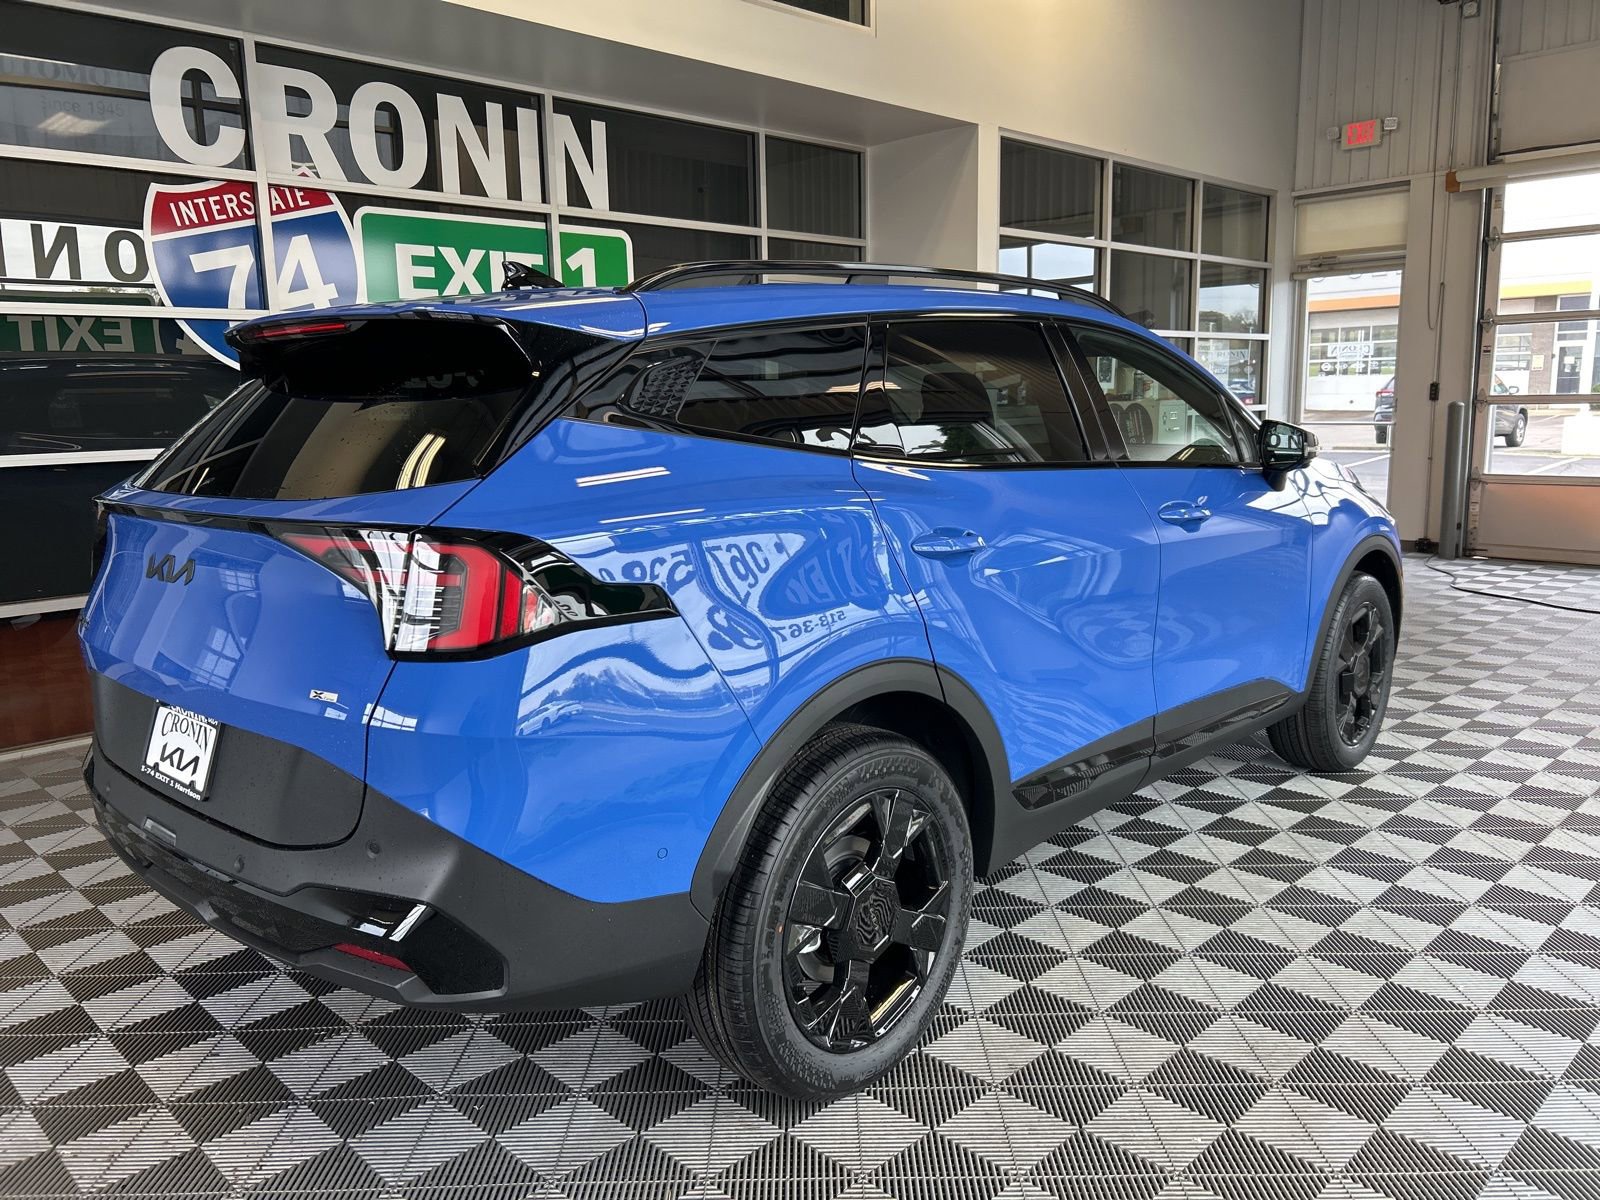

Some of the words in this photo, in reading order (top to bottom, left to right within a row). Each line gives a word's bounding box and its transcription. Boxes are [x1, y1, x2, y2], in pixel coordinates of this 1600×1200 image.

[150, 46, 609, 211] CRONIN
[170, 186, 310, 227] INTERSATE
[189, 234, 339, 324] 74
[565, 248, 597, 287] 1
[161, 712, 212, 754] CRONIN
[160, 742, 200, 777] KIA
[155, 772, 170, 785] EXIT
[174, 782, 201, 801] Harrison
